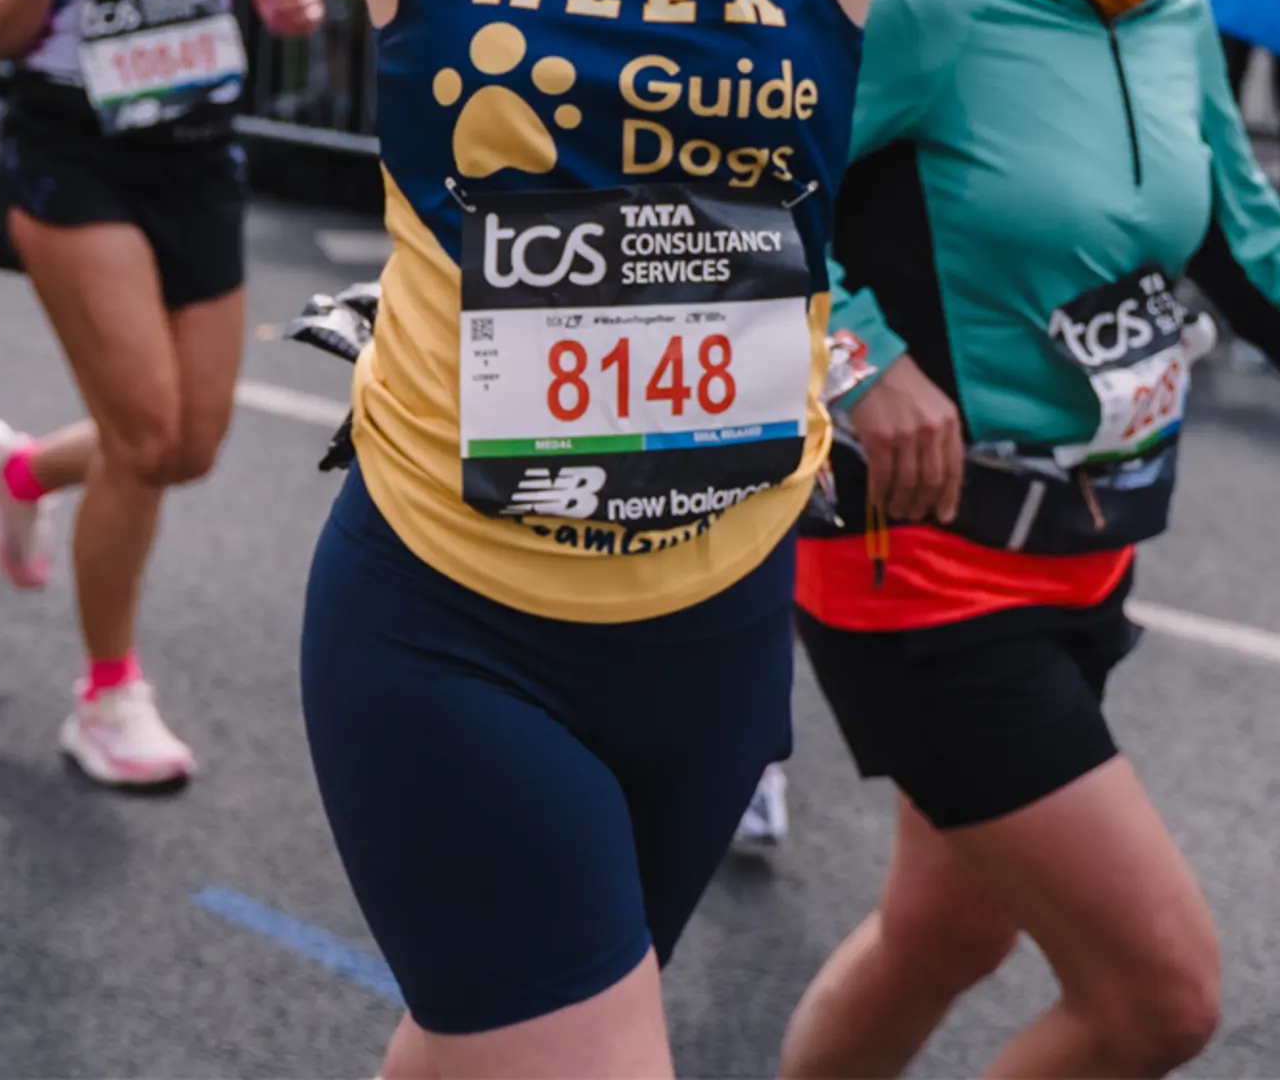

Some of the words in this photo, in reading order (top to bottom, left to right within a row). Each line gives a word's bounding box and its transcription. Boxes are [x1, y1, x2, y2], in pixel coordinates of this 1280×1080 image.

[619, 54, 818, 120] Guide
[622, 118, 795, 188] Dogs
[620, 204, 696, 228] TATA
[621, 230, 782, 256] CONSULTANCY
[483, 213, 607, 288] tcs
[622, 259, 731, 284] SERVICES
[1049, 298, 1154, 367] tcs
[546, 333, 737, 422] 8148
[608, 495, 665, 521] new
